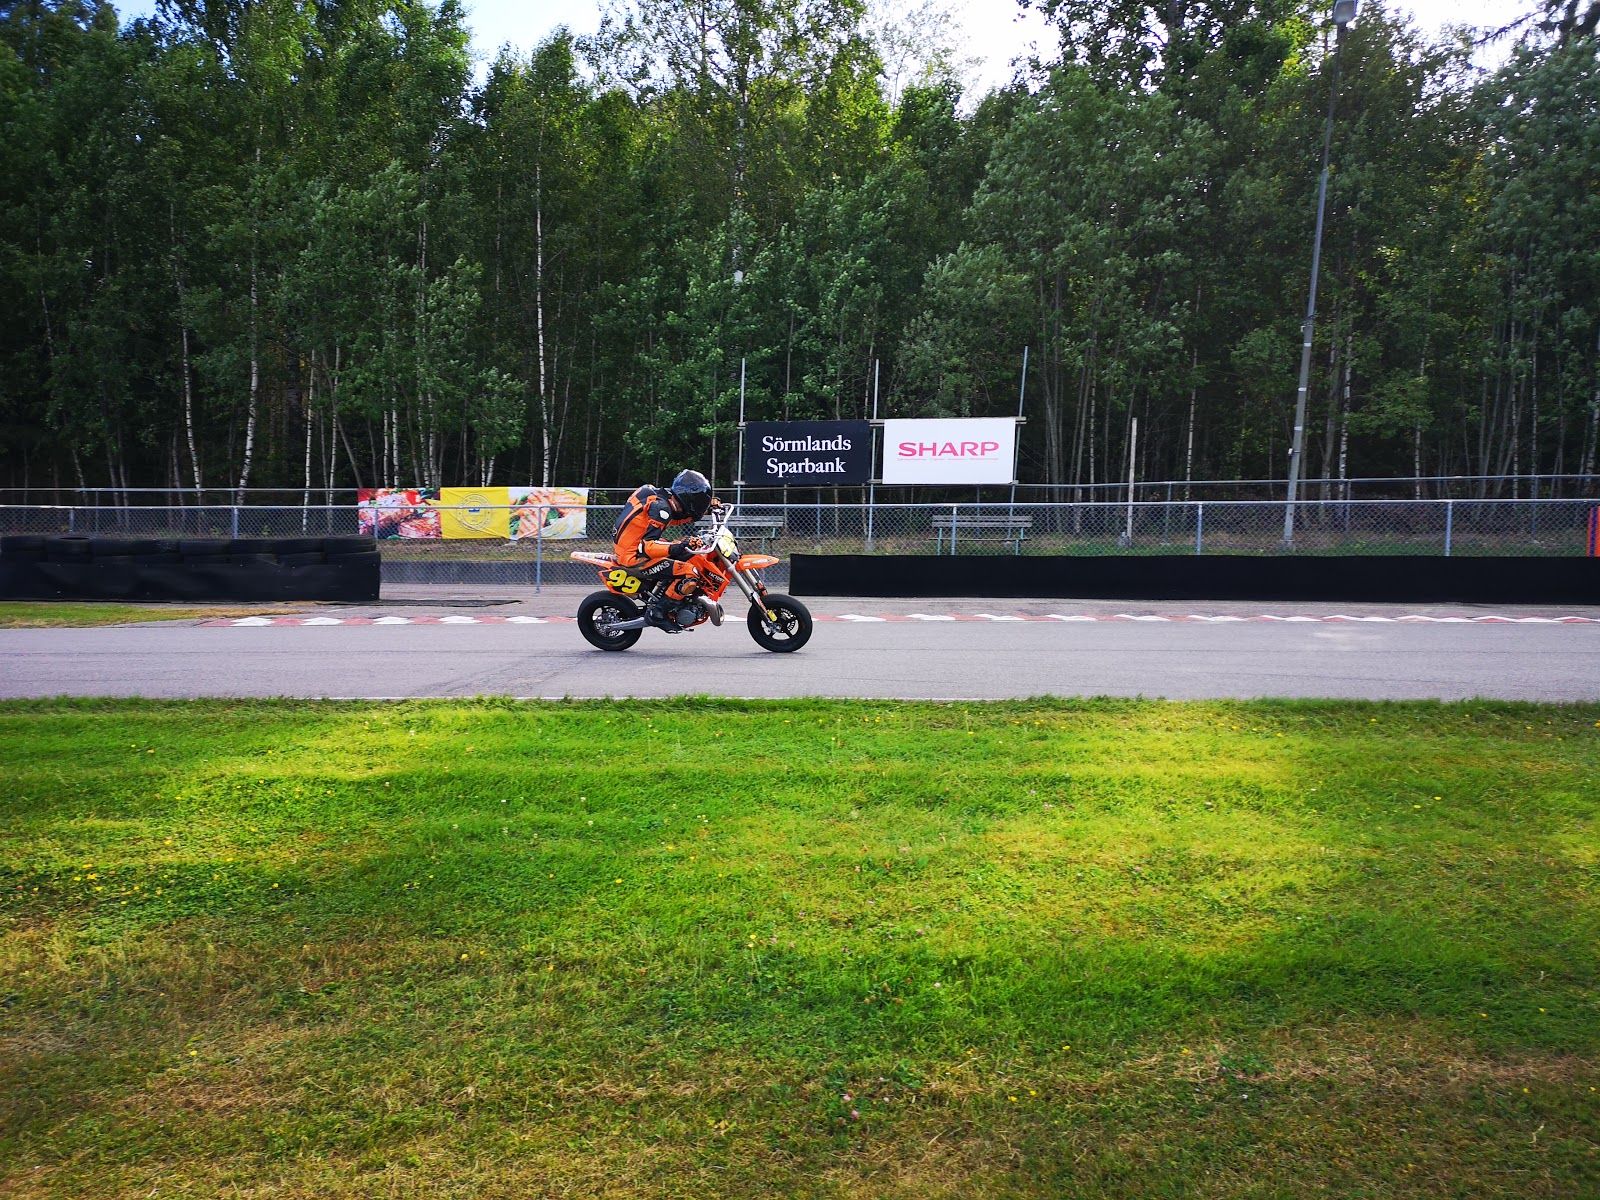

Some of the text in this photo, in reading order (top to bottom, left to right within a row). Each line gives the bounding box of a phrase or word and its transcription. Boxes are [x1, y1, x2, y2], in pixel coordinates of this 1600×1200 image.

[762, 434, 852, 452] Sörmlands
[898, 441, 999, 457] SHARP
[766, 457, 847, 478] Sparbank
[606, 569, 642, 593] 99
